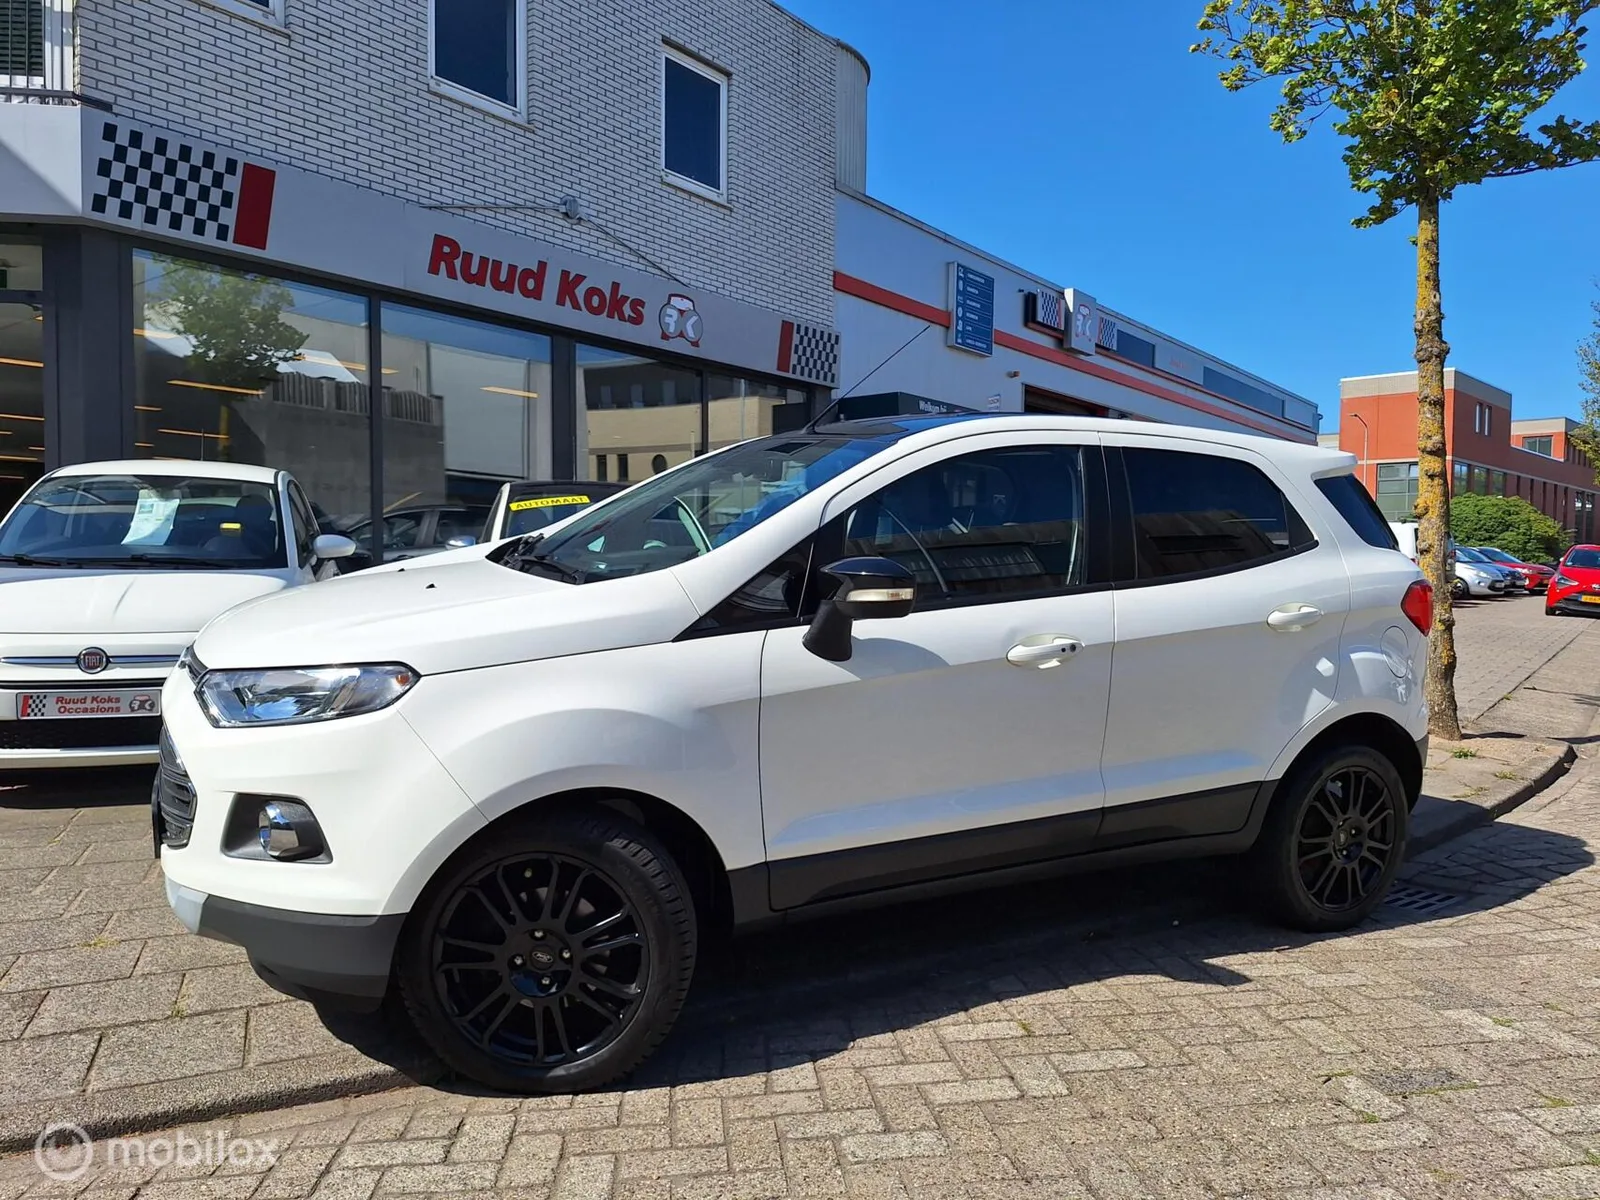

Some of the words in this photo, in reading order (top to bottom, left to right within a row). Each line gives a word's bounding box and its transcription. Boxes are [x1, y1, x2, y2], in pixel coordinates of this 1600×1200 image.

[427, 233, 548, 301] Ruud
[556, 269, 646, 326] Koks
[515, 497, 584, 509] AUTOMAAT
[85, 655, 101, 667] FIAT
[56, 695, 87, 705] Ruud
[90, 695, 121, 704] Koks
[57, 705, 121, 714] Occasions
